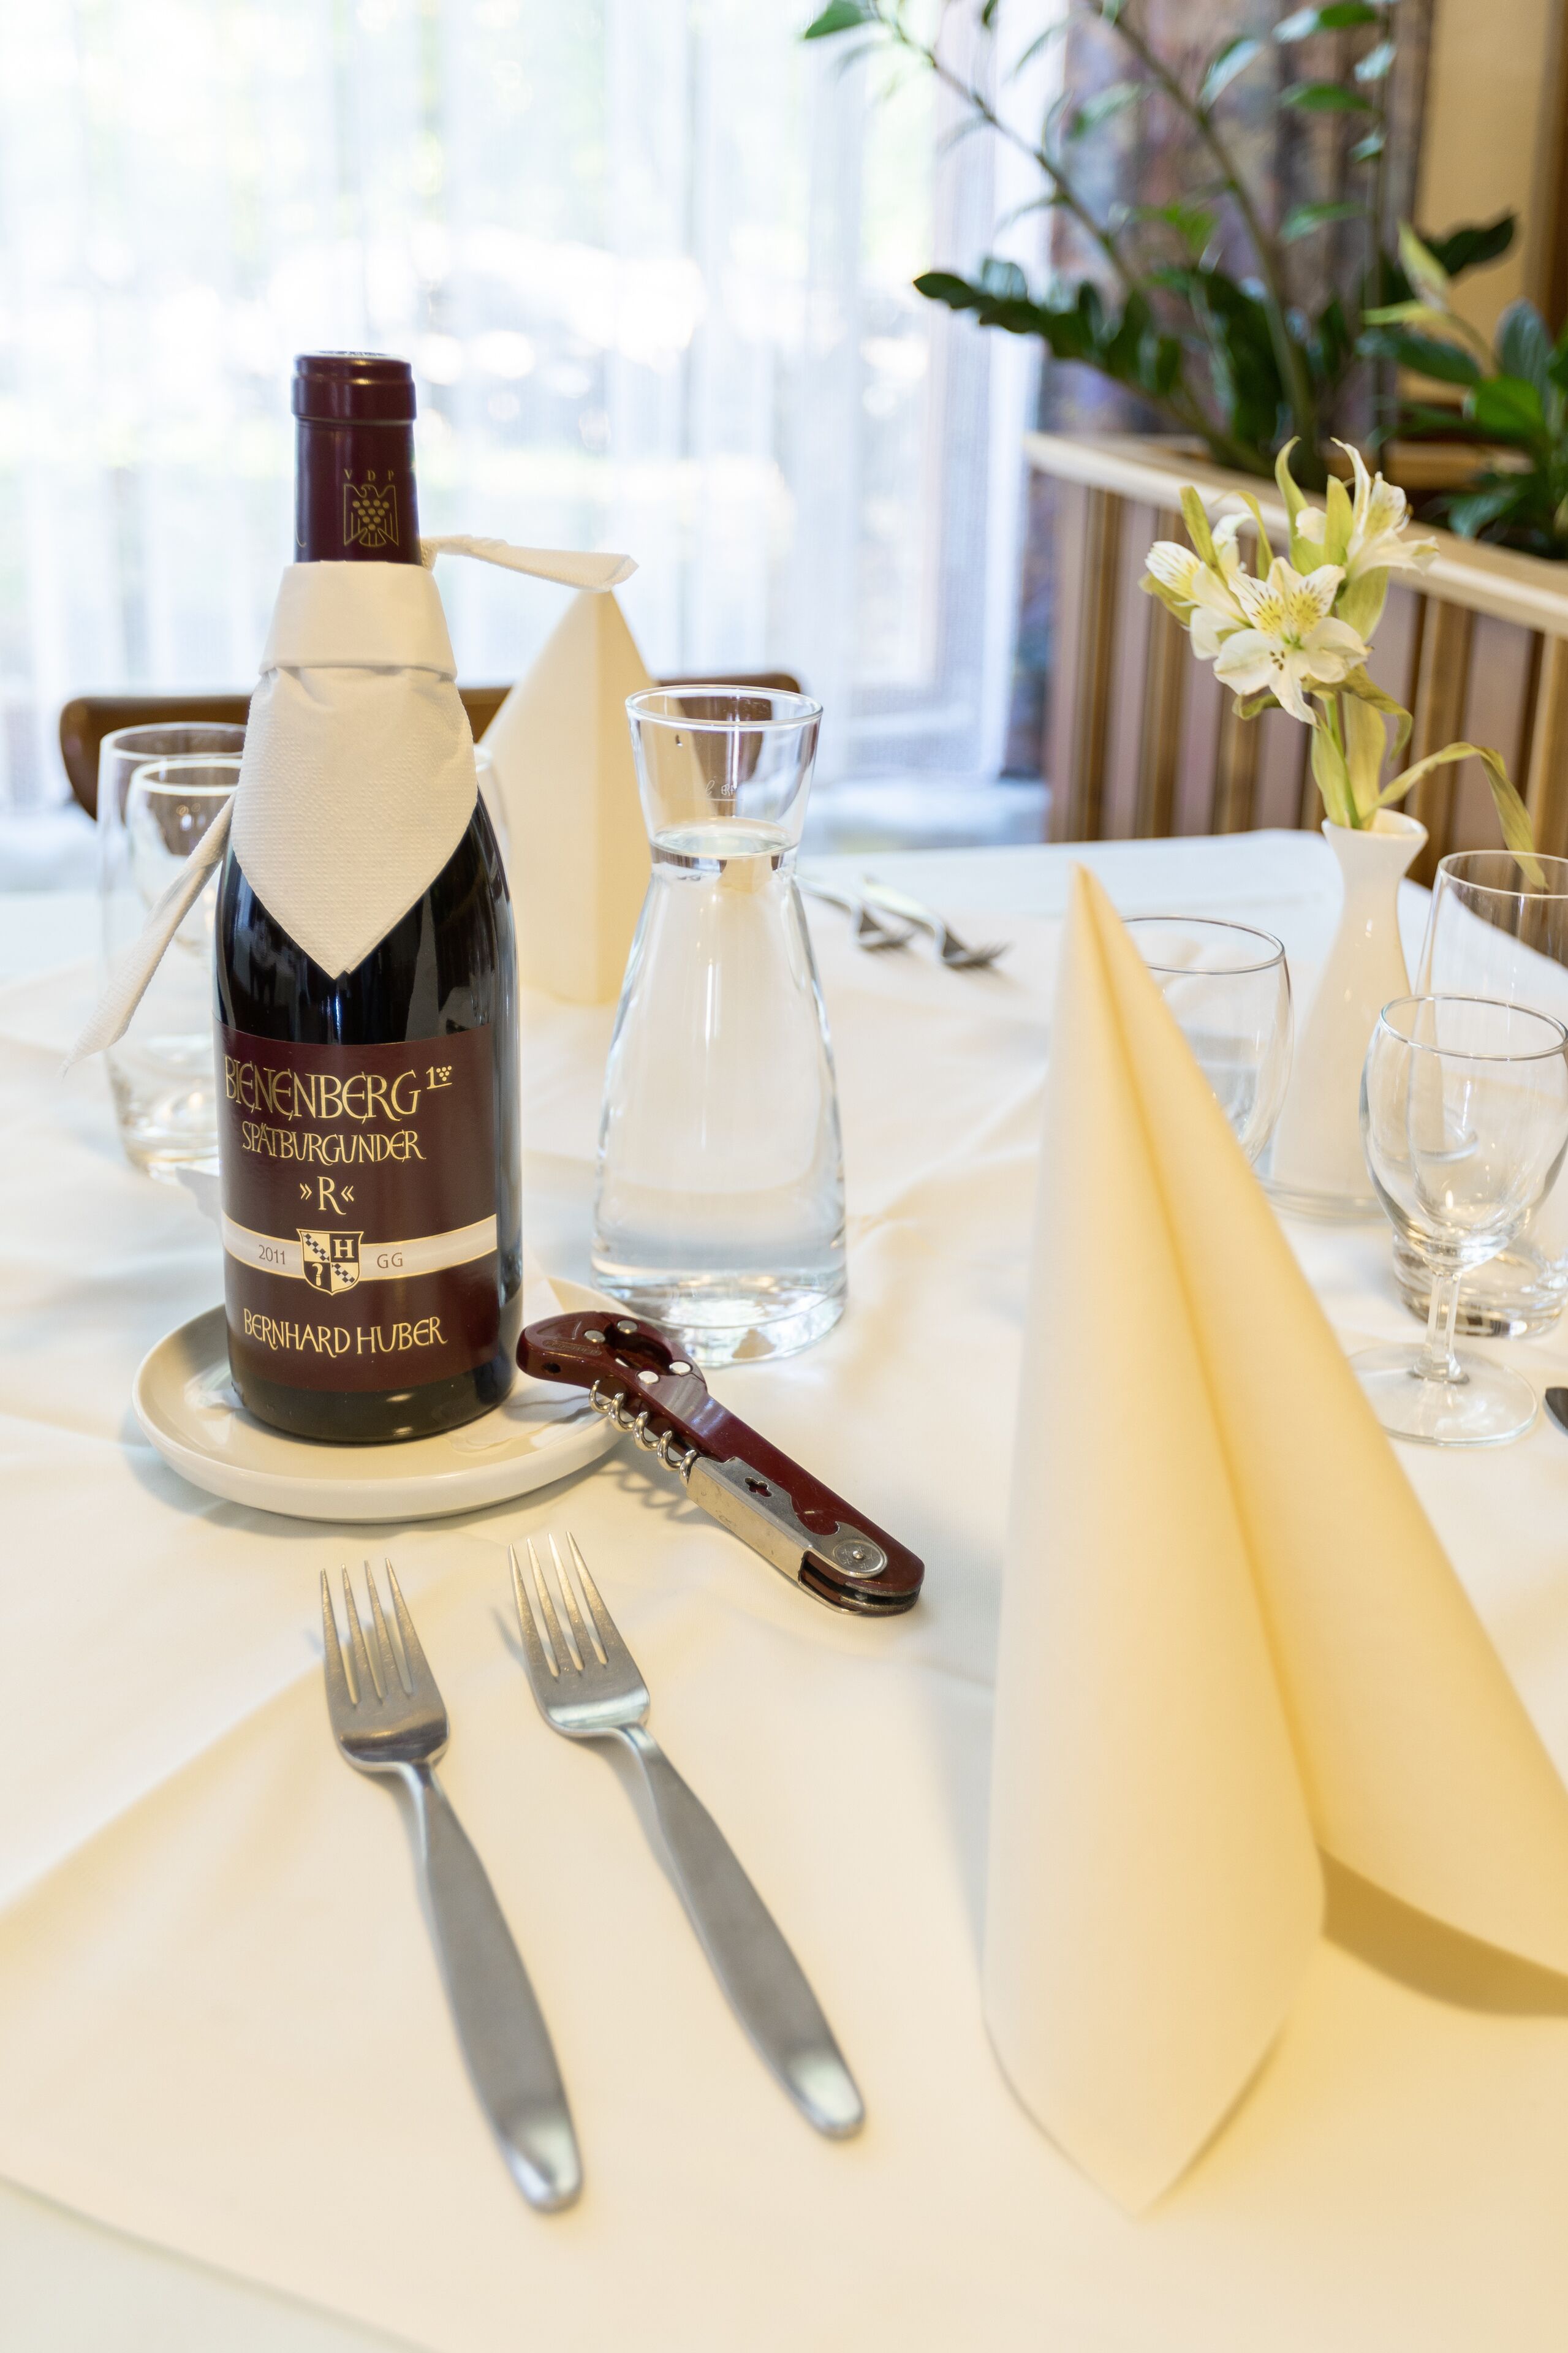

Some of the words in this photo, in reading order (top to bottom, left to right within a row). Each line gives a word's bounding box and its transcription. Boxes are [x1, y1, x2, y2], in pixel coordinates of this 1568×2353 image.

[224, 1055, 421, 1123] BIENENBERG
[243, 1121, 426, 1165] SPÄTBURGUNDER
[259, 1245, 286, 1265] 2011
[335, 1239, 354, 1258] H
[377, 1252, 403, 1269] GG
[244, 1308, 350, 1358] BERNHARD
[357, 1317, 447, 1354] HUBER
